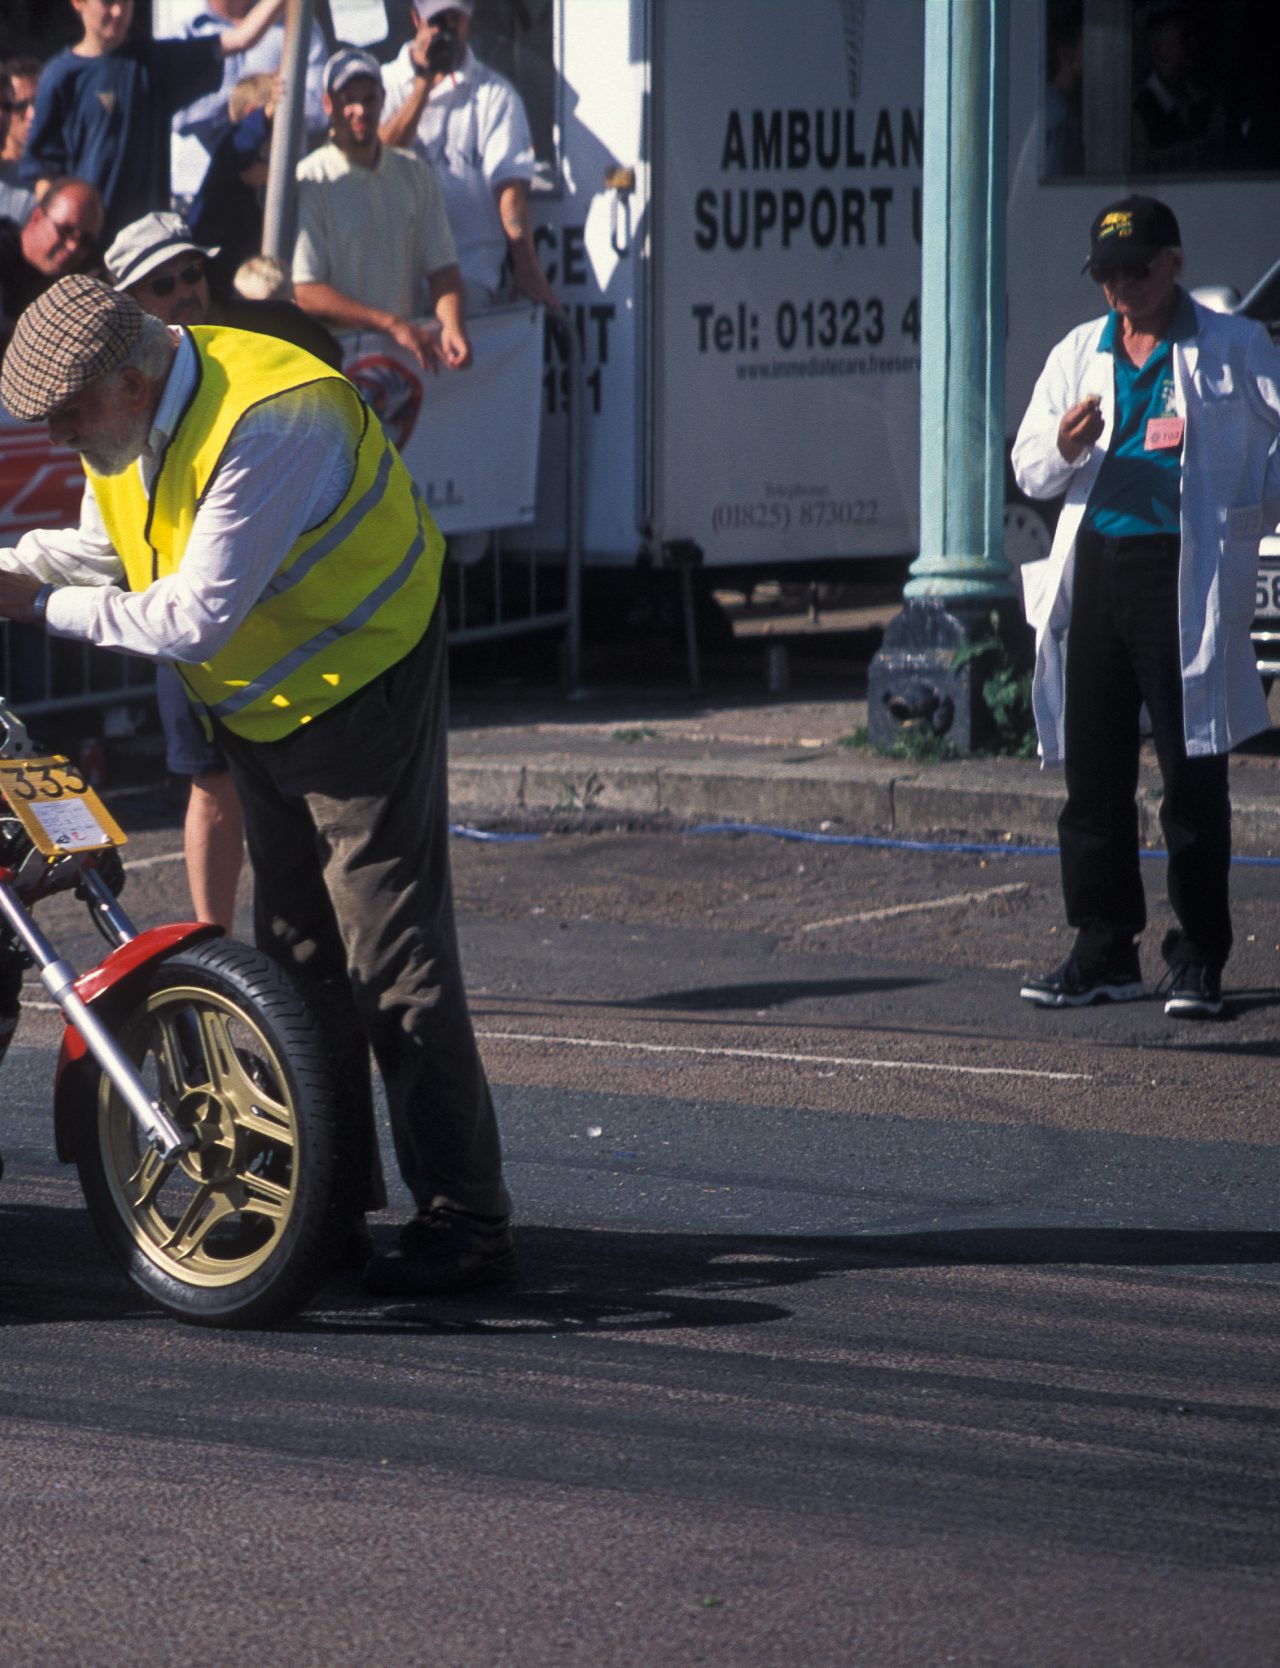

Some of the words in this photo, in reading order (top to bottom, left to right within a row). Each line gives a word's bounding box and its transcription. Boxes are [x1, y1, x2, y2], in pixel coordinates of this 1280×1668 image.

[694, 187, 894, 250] SUPPORT
[691, 302, 760, 353] Tel:
[776, 298, 886, 349] 01323
[0, 761, 89, 800] 333
